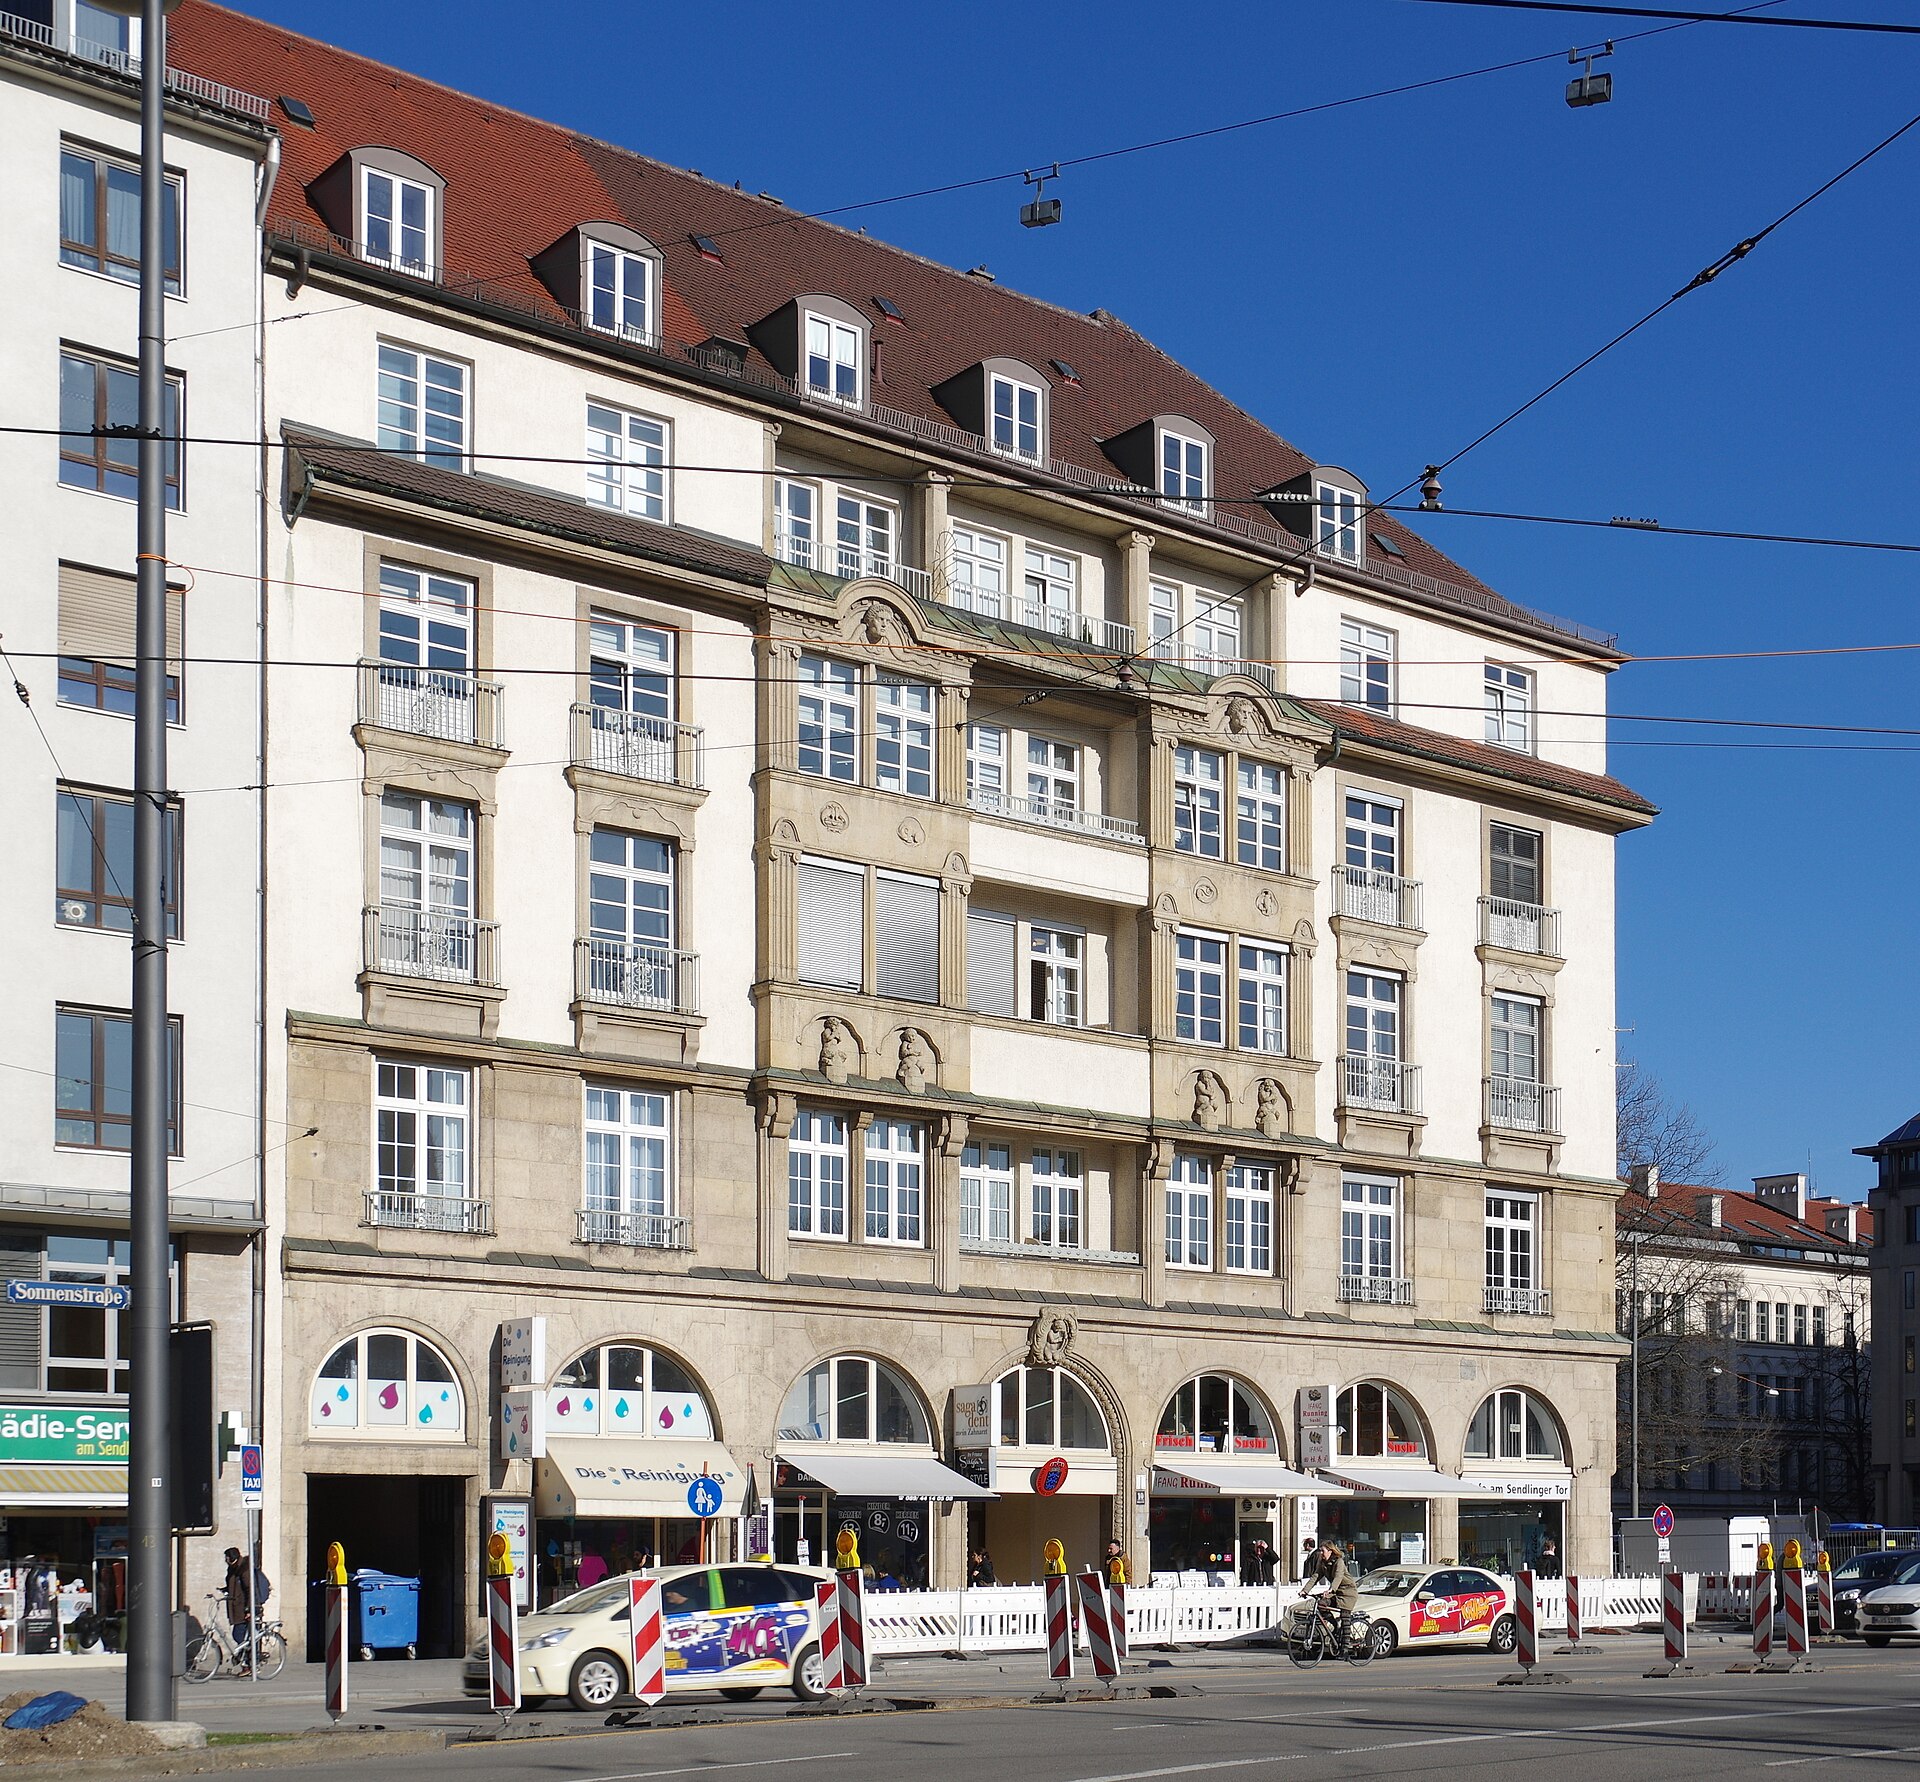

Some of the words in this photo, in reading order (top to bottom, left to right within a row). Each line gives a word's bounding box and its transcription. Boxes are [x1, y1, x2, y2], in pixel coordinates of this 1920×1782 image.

[15, 1283, 123, 1306] Sonnenstraße
[503, 1337, 511, 1347] Die
[502, 1353, 531, 1366] Reinigung
[956, 1402, 976, 1418] saga
[968, 1411, 989, 1428] dent
[0, 1413, 130, 1440] ädie-Ser
[1156, 1434, 1194, 1447] Frisch
[1234, 1435, 1268, 1449] Sushi
[1387, 1440, 1418, 1453] Sushi
[76, 1444, 95, 1455] am
[576, 1467, 607, 1479] Die
[622, 1467, 726, 1485] Reinigug
[243, 1478, 261, 1489] TAXI
[1506, 1484, 1552, 1497] Sendlinger
[1555, 1485, 1568, 1495] Tor
[867, 1502, 890, 1510] KINDER
[838, 1510, 862, 1519] DAMEN
